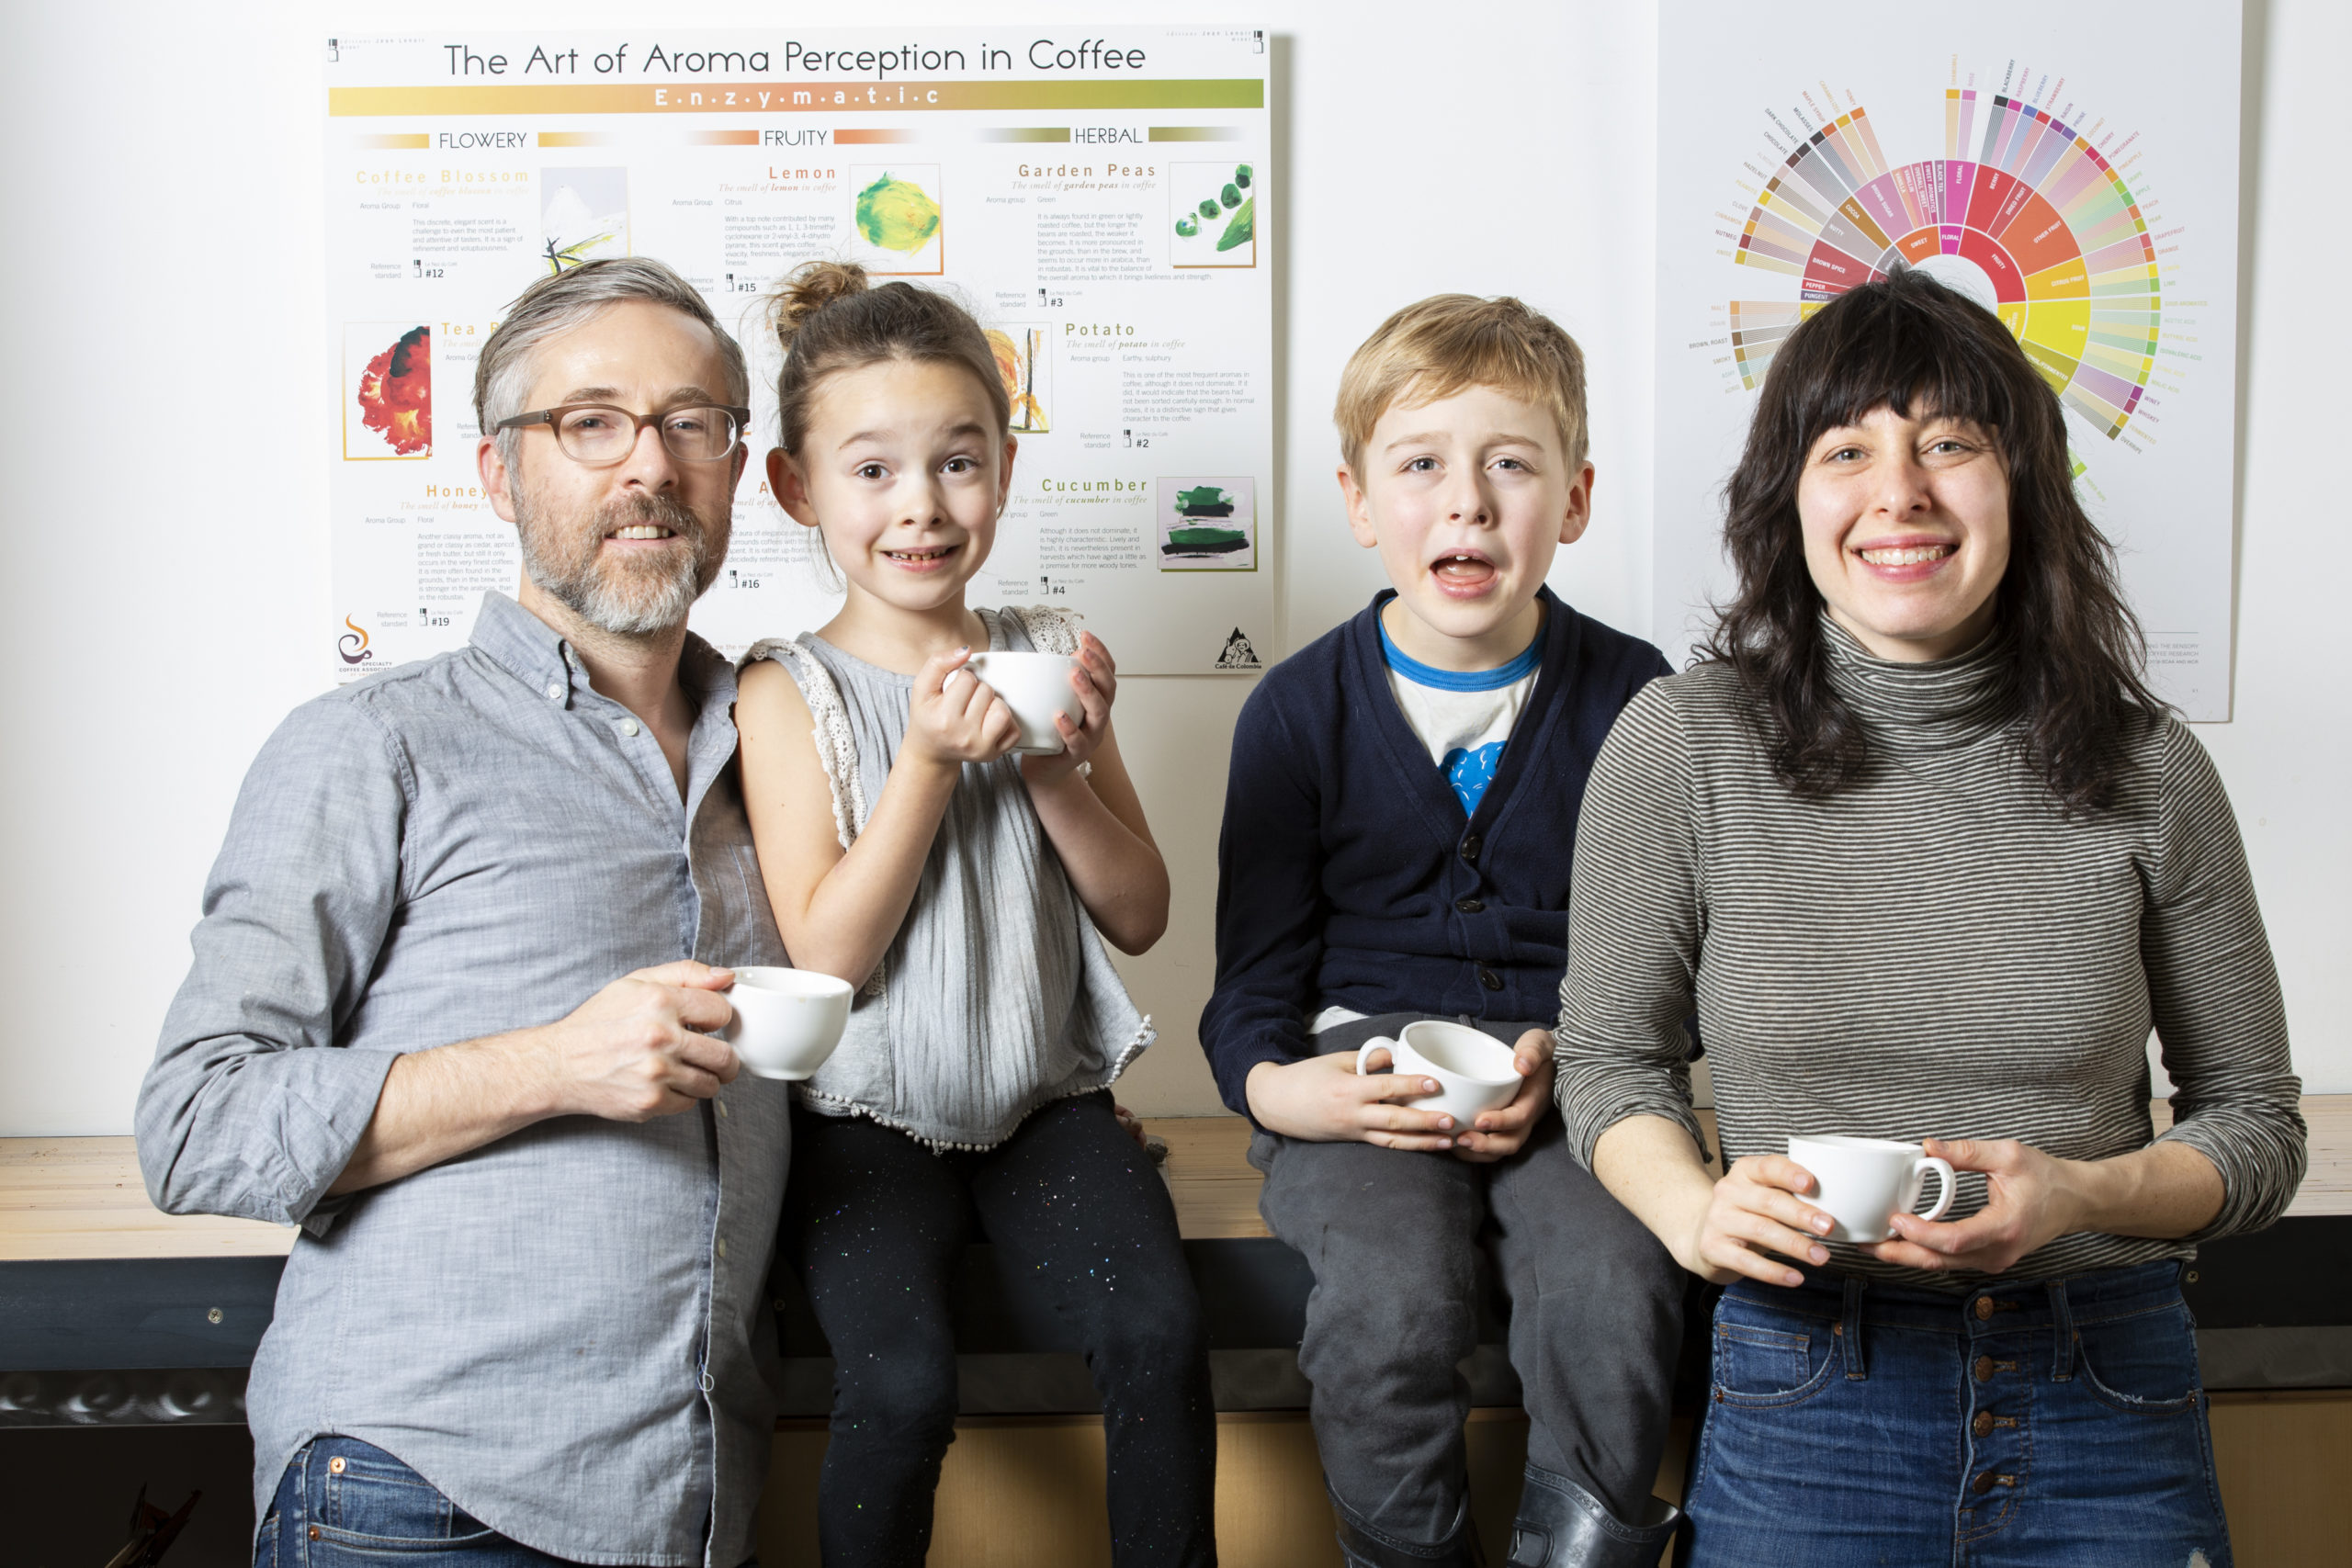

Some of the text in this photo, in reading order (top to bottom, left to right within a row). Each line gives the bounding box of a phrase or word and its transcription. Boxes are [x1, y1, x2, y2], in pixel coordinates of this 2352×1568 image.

[444, 39, 1146, 80] The Art of Aroma Perception in Coffee
[2002, 59, 2016, 93] BLACKBERRY
[1793, 107, 1814, 131] MOLASSES
[440, 132, 526, 148] FLOWERY
[765, 130, 827, 146] FRUITY
[1076, 128, 1143, 143] HERBAL
[1763, 131, 1788, 155] CHOCOLATE
[770, 166, 835, 179] Lemon
[1019, 164, 1154, 176] Garden Peas
[356, 169, 527, 184] Coffee Blossom
[1989, 173, 2000, 190] BERRY
[719, 183, 733, 192] The
[736, 183, 759, 192] smell
[761, 183, 768, 194] of
[771, 183, 799, 192] lemon
[813, 182, 837, 193] coffee
[1012, 181, 1027, 189] The
[1030, 181, 1052, 189] smell
[1054, 181, 1063, 191] of
[1064, 181, 1096, 191] garden
[1097, 182, 1119, 191] peas
[1132, 180, 1156, 191] coffee
[1871, 184, 1894, 219] BROWN SUGAR
[2006, 186, 2027, 216] DRIED FRUIT
[1845, 204, 1860, 220] COCOA
[1715, 229, 1737, 241] NUTMEG
[1828, 224, 1844, 236] NUTTY
[2033, 220, 2062, 244] OTHER FRUIT
[2154, 226, 2185, 241] GRAPEFRUIT
[1910, 238, 1928, 248] SWEET
[1812, 257, 1846, 274] BROWN SPICE
[1991, 254, 2007, 270] FRUITY
[426, 269, 443, 277] #12
[739, 283, 756, 291] #15
[1806, 282, 1826, 290] PEPPER
[2051, 275, 2085, 287] CITRUS FRUIT
[1051, 299, 1063, 307] #3
[442, 321, 475, 336] Tea
[1066, 323, 1134, 335] Potato
[1067, 340, 1081, 349] The
[1084, 340, 1106, 348] smell
[1108, 340, 1117, 350] of
[1117, 341, 1148, 351] potato
[1161, 339, 1185, 350] coffee
[1710, 337, 1728, 345] ROAST
[1136, 439, 1148, 447] #2
[1042, 479, 1147, 491] Cucumber
[426, 485, 488, 501] Honey
[1014, 494, 1148, 506] The smell of cucumber in coffee
[452, 502, 479, 512] honey
[1010, 511, 1029, 520] group
[742, 580, 759, 588] #16
[1053, 586, 1065, 594] #4
[432, 617, 449, 626] #19
